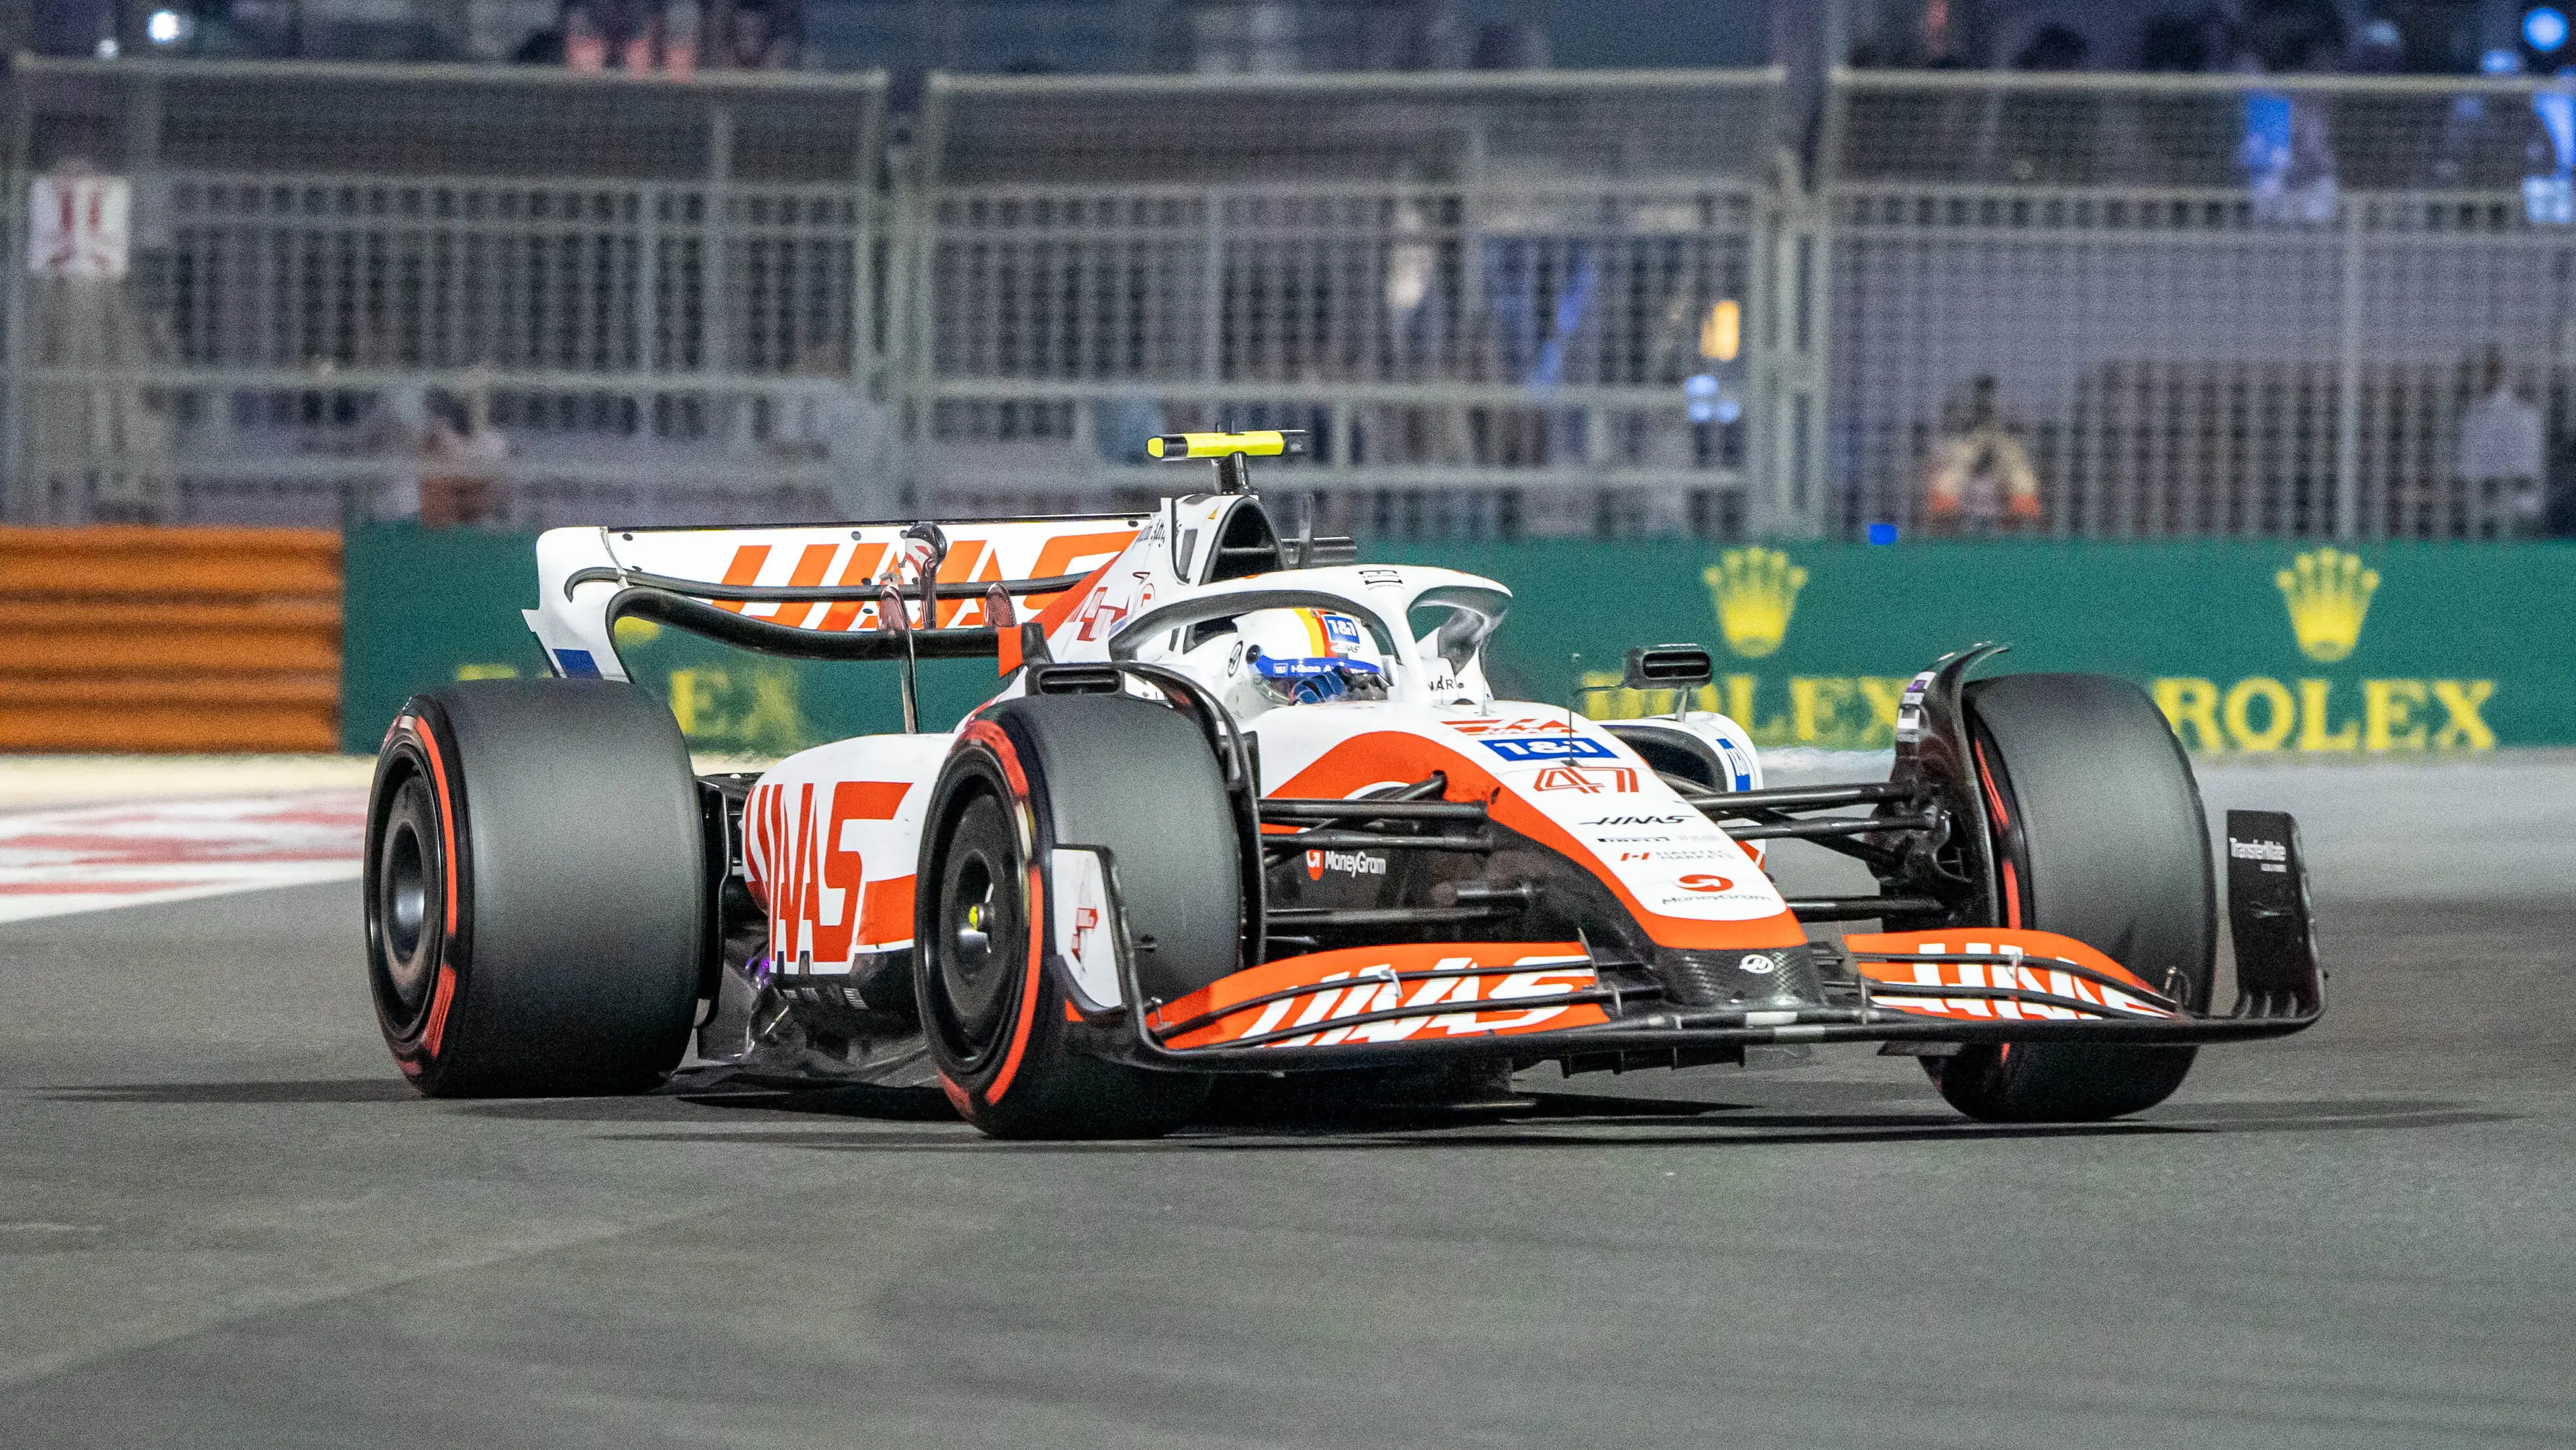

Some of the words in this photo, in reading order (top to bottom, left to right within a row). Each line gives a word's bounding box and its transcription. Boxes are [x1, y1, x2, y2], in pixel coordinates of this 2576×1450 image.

[1327, 618, 1358, 637] 1&1
[2152, 677, 2496, 754] ROLEX
[1494, 741, 1599, 756] 1&1
[1532, 767, 1640, 794] 47
[1578, 815, 1696, 826] HAAS
[742, 781, 914, 962] HAAS
[1324, 850, 1387, 879] MoneyGram
[1661, 894, 1772, 905] MoneyGram
[1240, 954, 1595, 1048] HAAS
